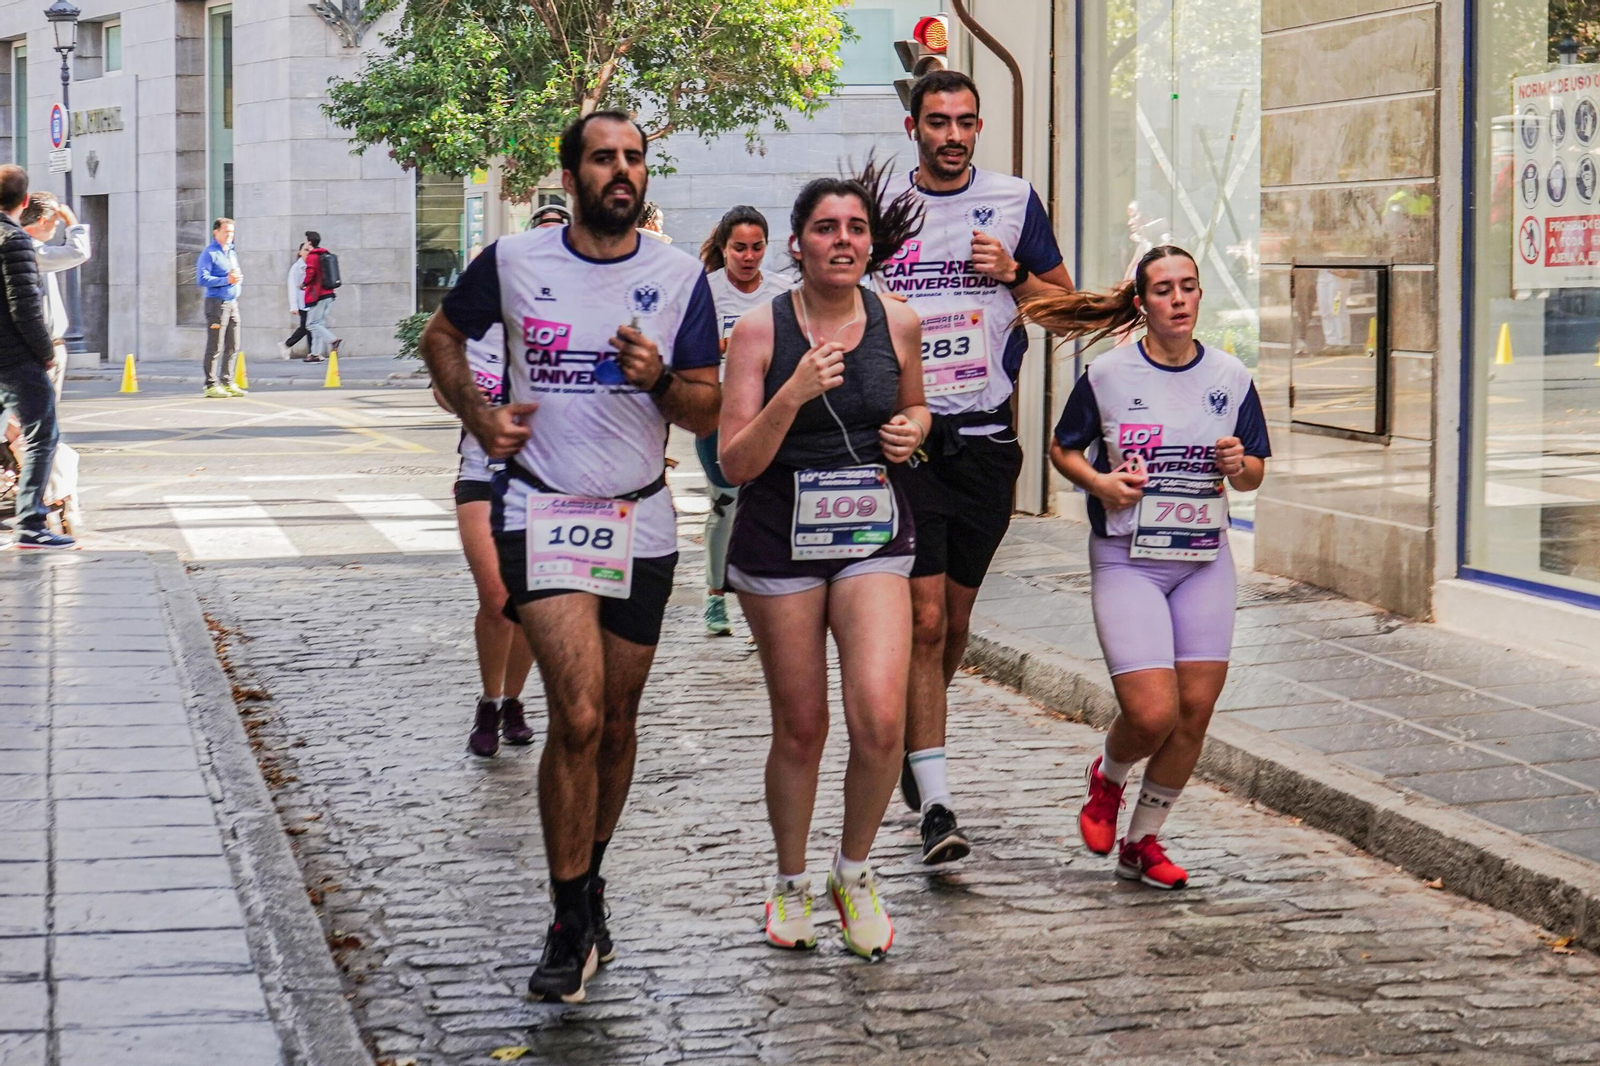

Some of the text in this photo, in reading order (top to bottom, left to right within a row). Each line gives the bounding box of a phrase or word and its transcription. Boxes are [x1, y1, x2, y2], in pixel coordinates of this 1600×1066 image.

[1558, 77, 1569, 93] DE
[1570, 74, 1592, 91] USO
[1549, 236, 1557, 248] A
[886, 276, 1000, 292] UNIVERSIDAD
[1121, 426, 1161, 446] 10ª
[814, 495, 877, 519] 109
[1154, 502, 1212, 524] 701
[548, 525, 614, 550] 108
